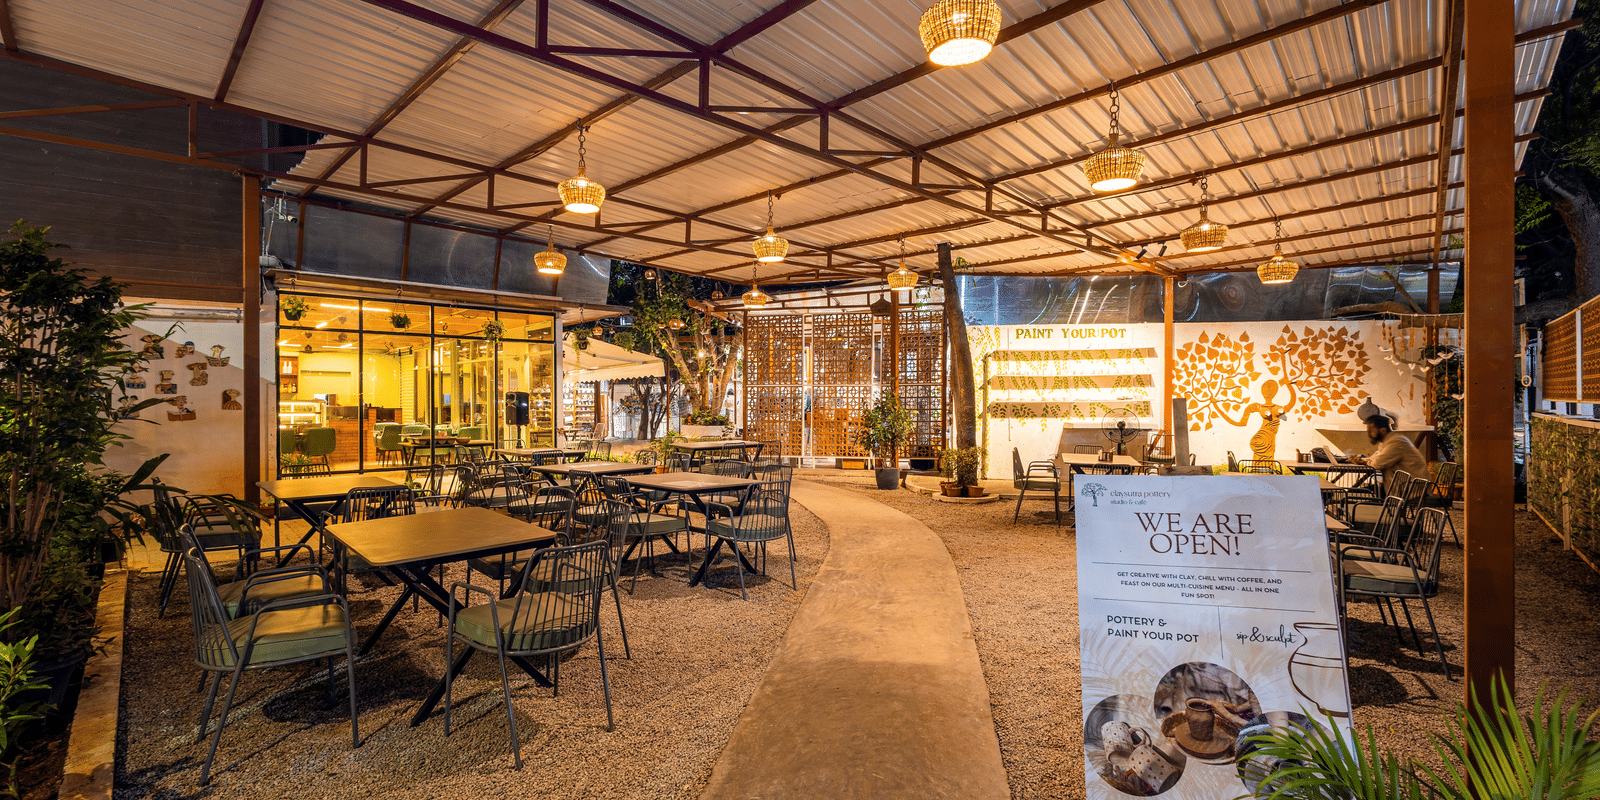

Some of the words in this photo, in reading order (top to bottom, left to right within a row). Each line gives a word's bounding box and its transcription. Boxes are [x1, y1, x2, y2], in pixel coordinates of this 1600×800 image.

[1016, 328, 1053, 339] PAINT
[1062, 328, 1096, 338] YOUR
[1101, 328, 1126, 338] POT
[1110, 490, 1142, 498] claysutra
[1144, 490, 1172, 499] pottery
[1134, 512, 1183, 532] WE
[1190, 512, 1255, 534] ARE
[1150, 533, 1241, 556] OPEN!
[1107, 615, 1154, 626] POTTERY
[1158, 618, 1167, 626] &
[1108, 628, 1138, 638] PAINT
[1142, 631, 1173, 641] YOUR
[1176, 634, 1199, 642] POT
